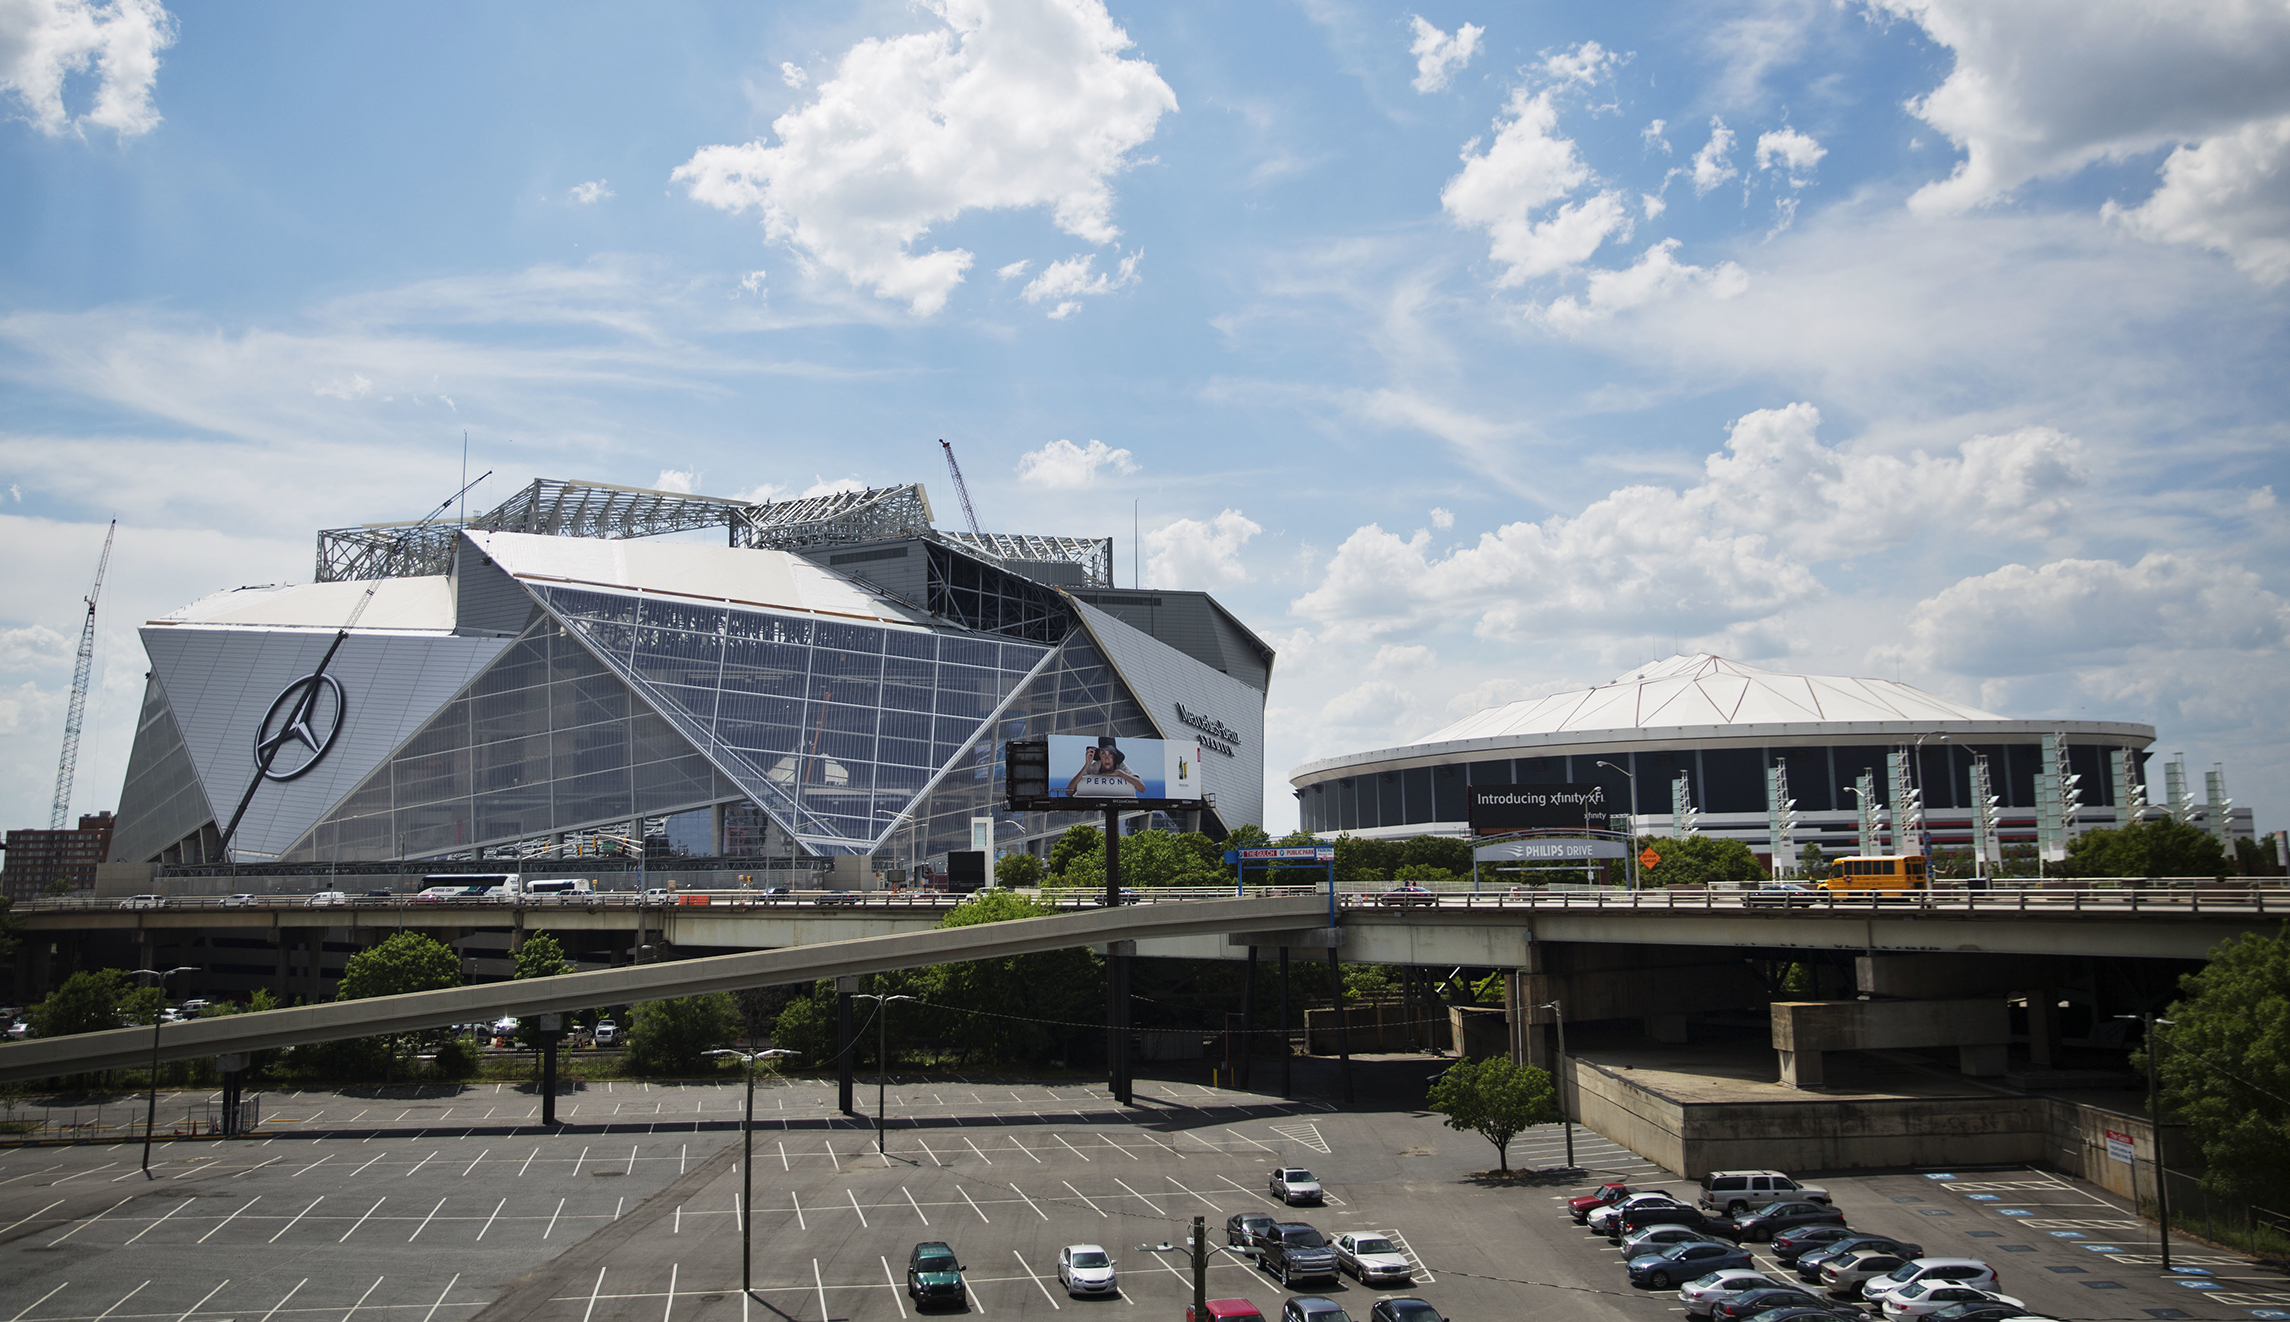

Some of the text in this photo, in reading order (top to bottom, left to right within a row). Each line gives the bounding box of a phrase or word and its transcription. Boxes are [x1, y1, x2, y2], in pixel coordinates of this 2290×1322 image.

[1175, 701, 1241, 745] Mercedes-Benz
[1197, 733, 1235, 757] STADIUM
[1086, 777, 1128, 785] PERONI
[1477, 791, 1604, 807] Introducing xfinity xFi
[1525, 844, 1593, 858] PHILIPS DRIVE
